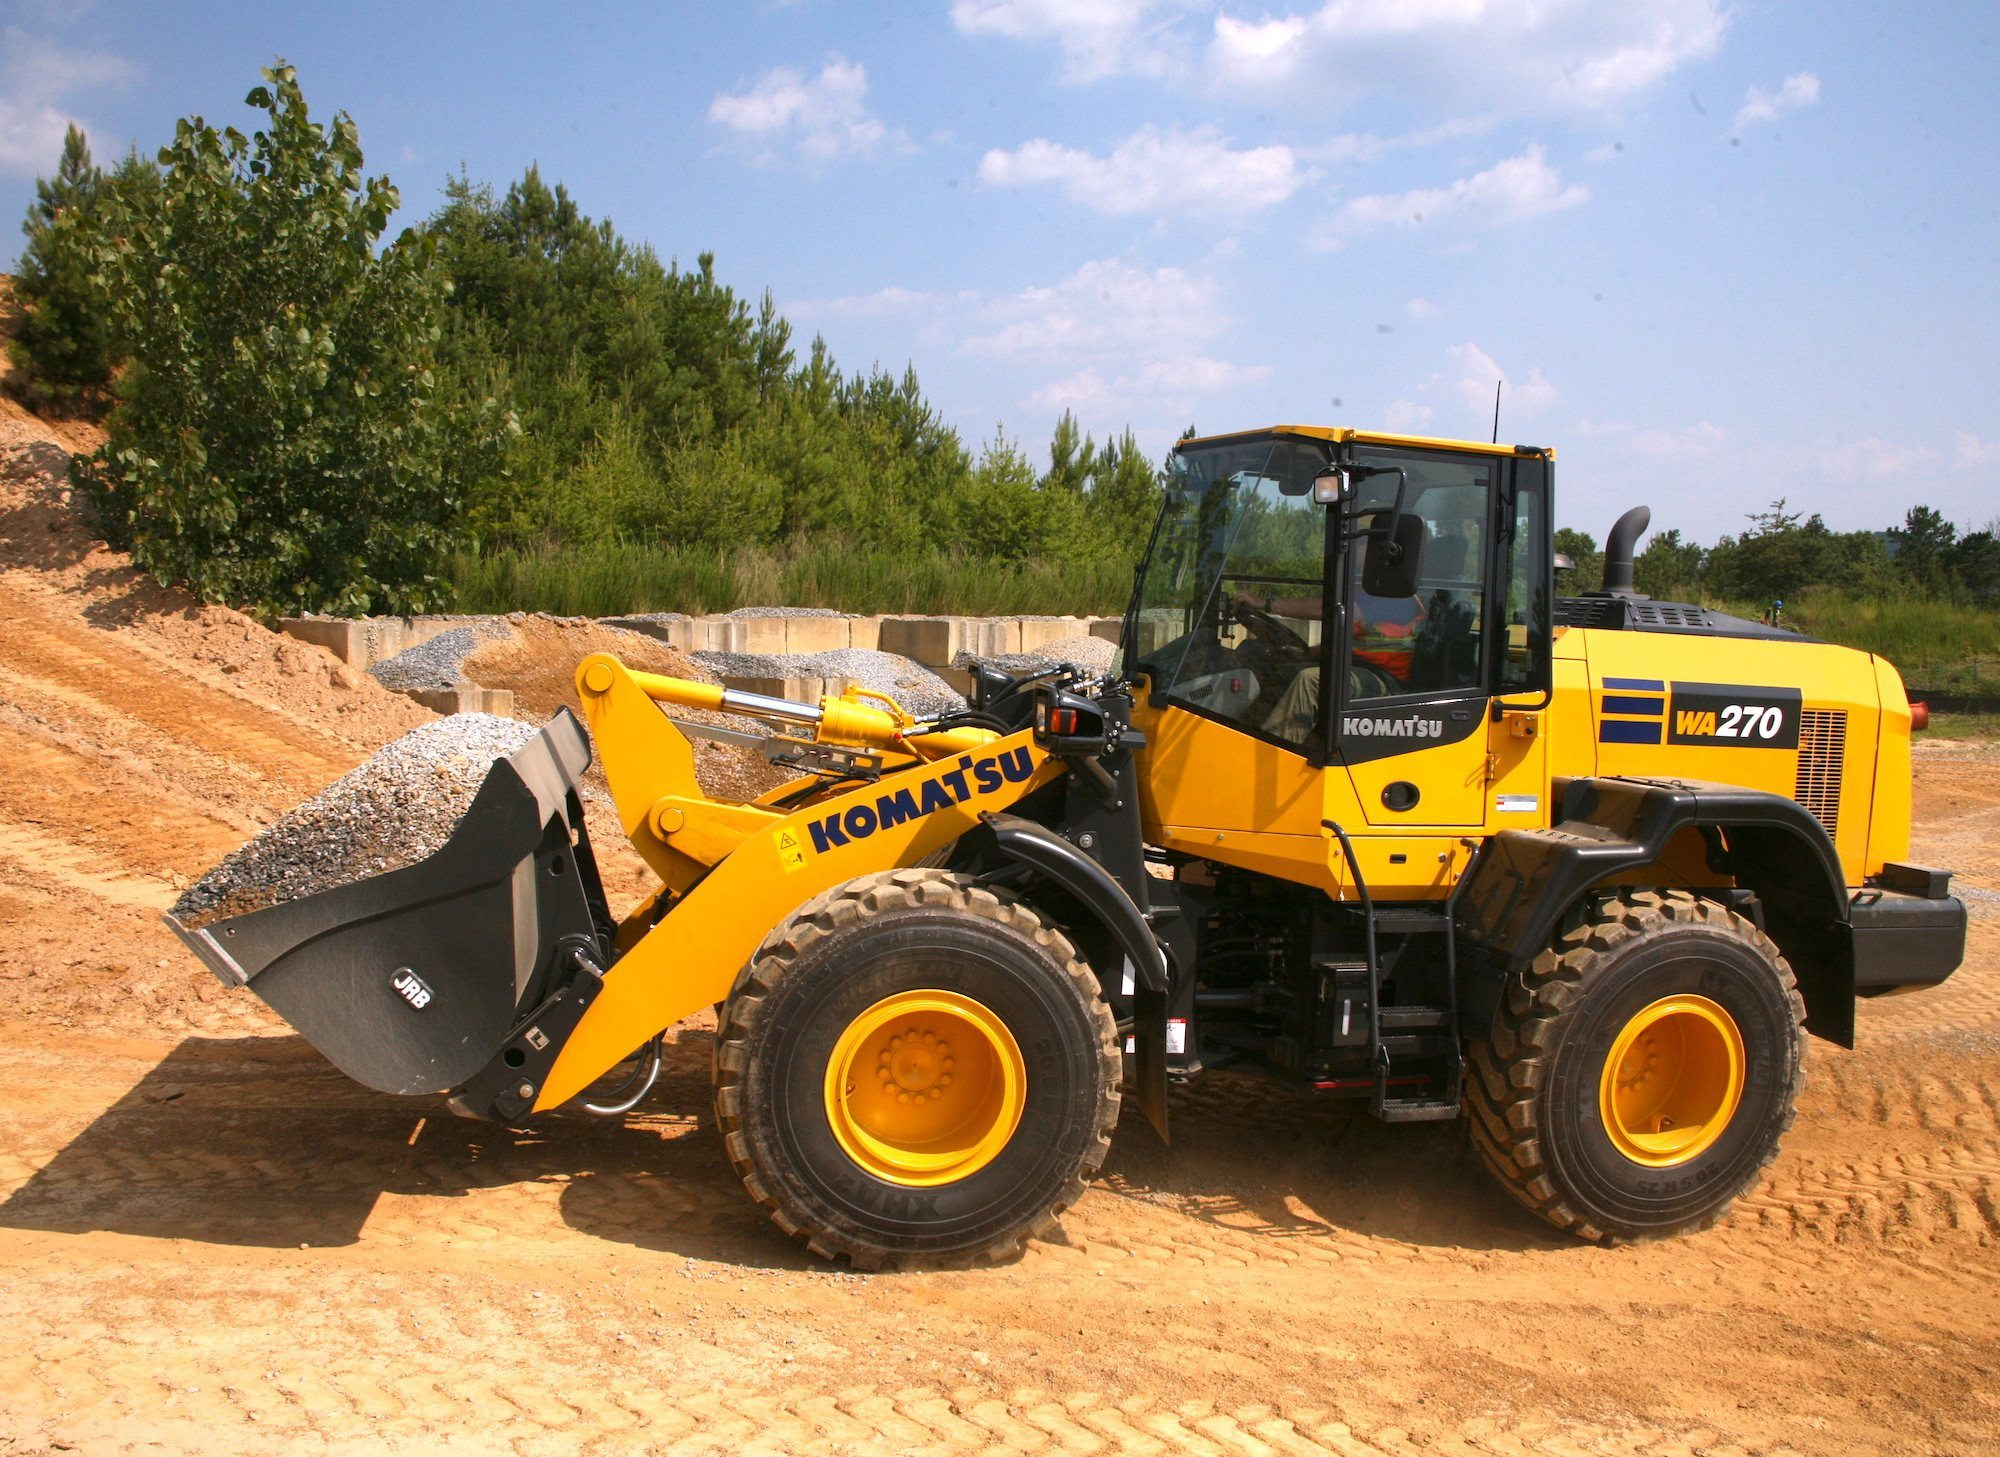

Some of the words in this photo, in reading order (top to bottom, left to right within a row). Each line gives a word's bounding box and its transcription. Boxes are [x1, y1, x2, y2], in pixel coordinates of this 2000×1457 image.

[1343, 714, 1443, 738] KOMATSU
[1676, 705, 1783, 739] WA270
[808, 746, 1035, 854] KOMATSU
[393, 973, 431, 1008] JRB
